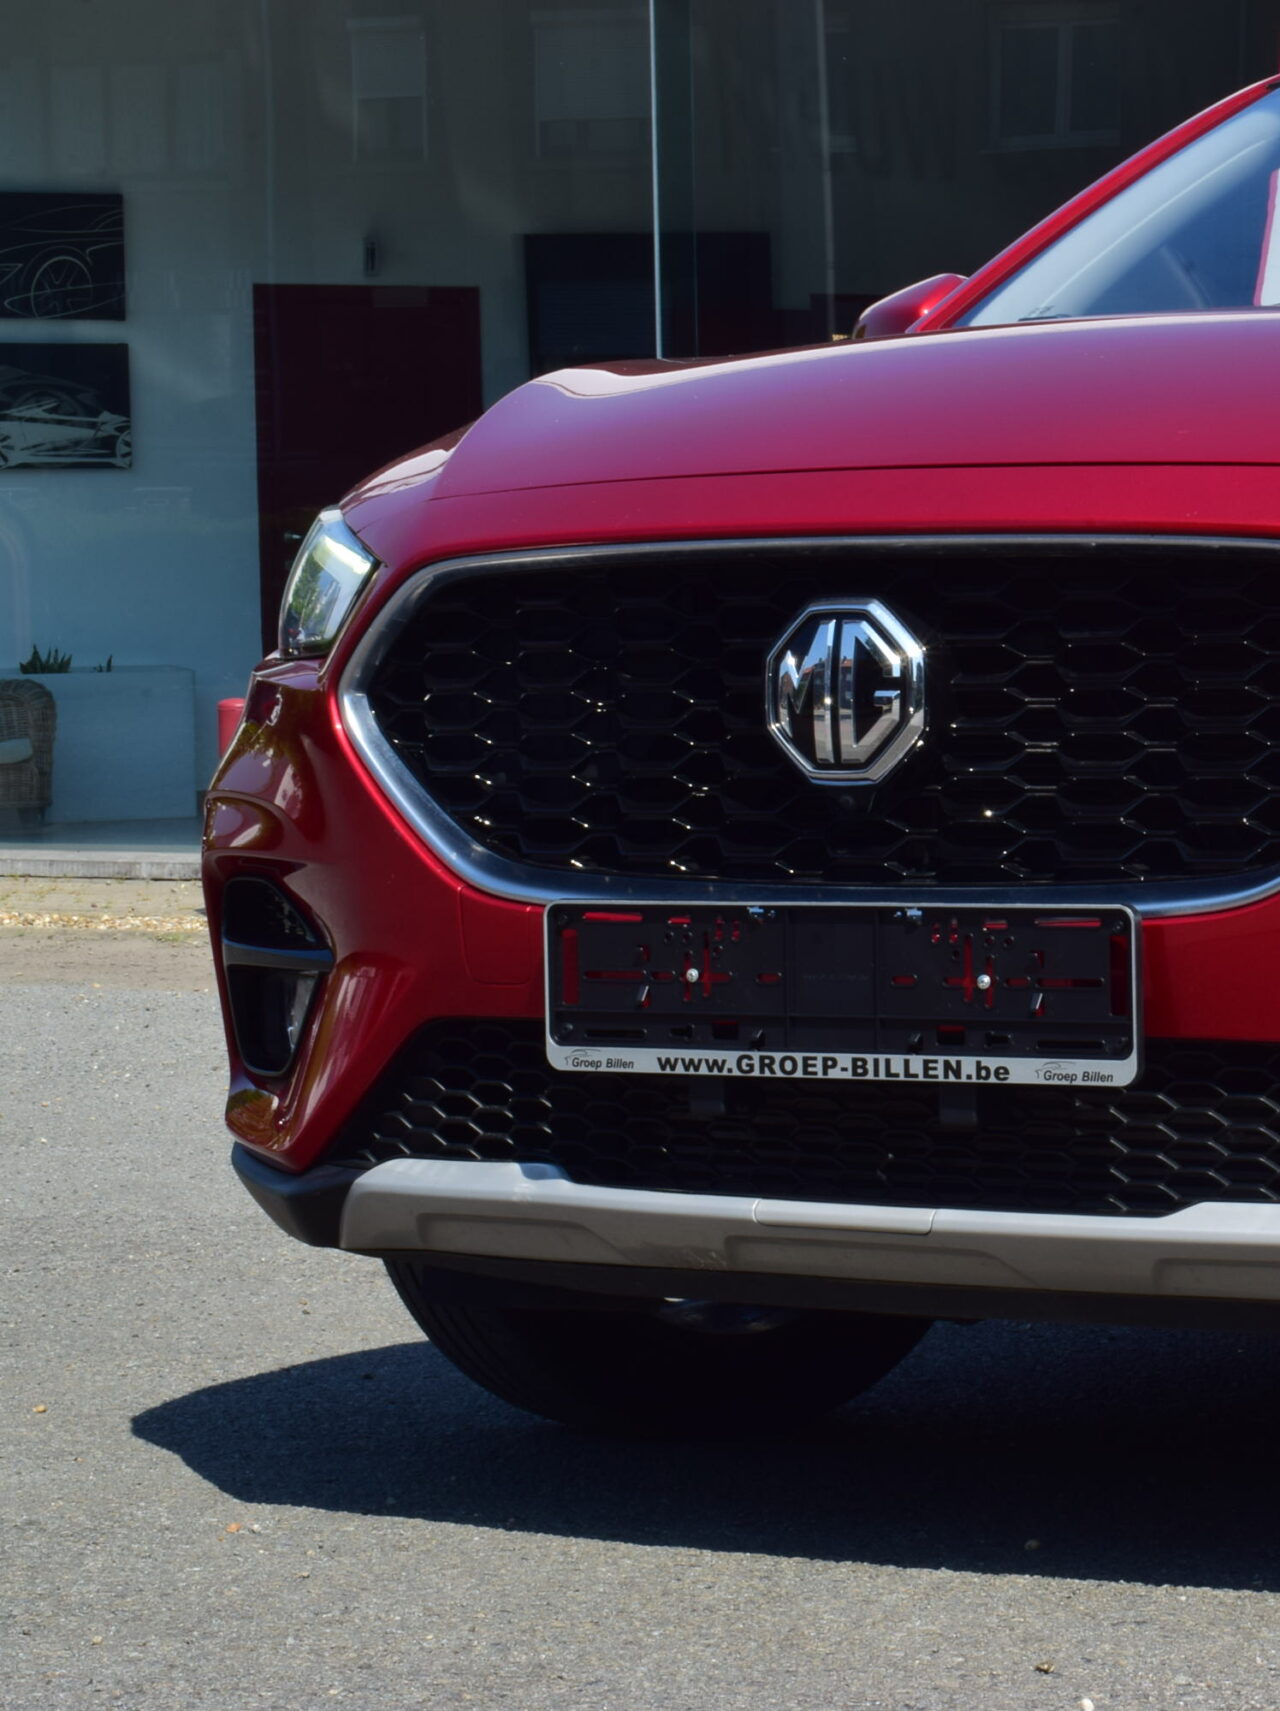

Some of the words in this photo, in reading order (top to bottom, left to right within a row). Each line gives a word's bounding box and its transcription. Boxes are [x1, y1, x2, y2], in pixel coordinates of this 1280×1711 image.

[778, 618, 902, 765] MG
[571, 1055, 602, 1070] Groep
[605, 1058, 634, 1069] Billen
[656, 1053, 1011, 1082] www.GROEP-BILLEN.be
[1043, 1069, 1078, 1083] Groep
[1081, 1071, 1114, 1083] Billen
